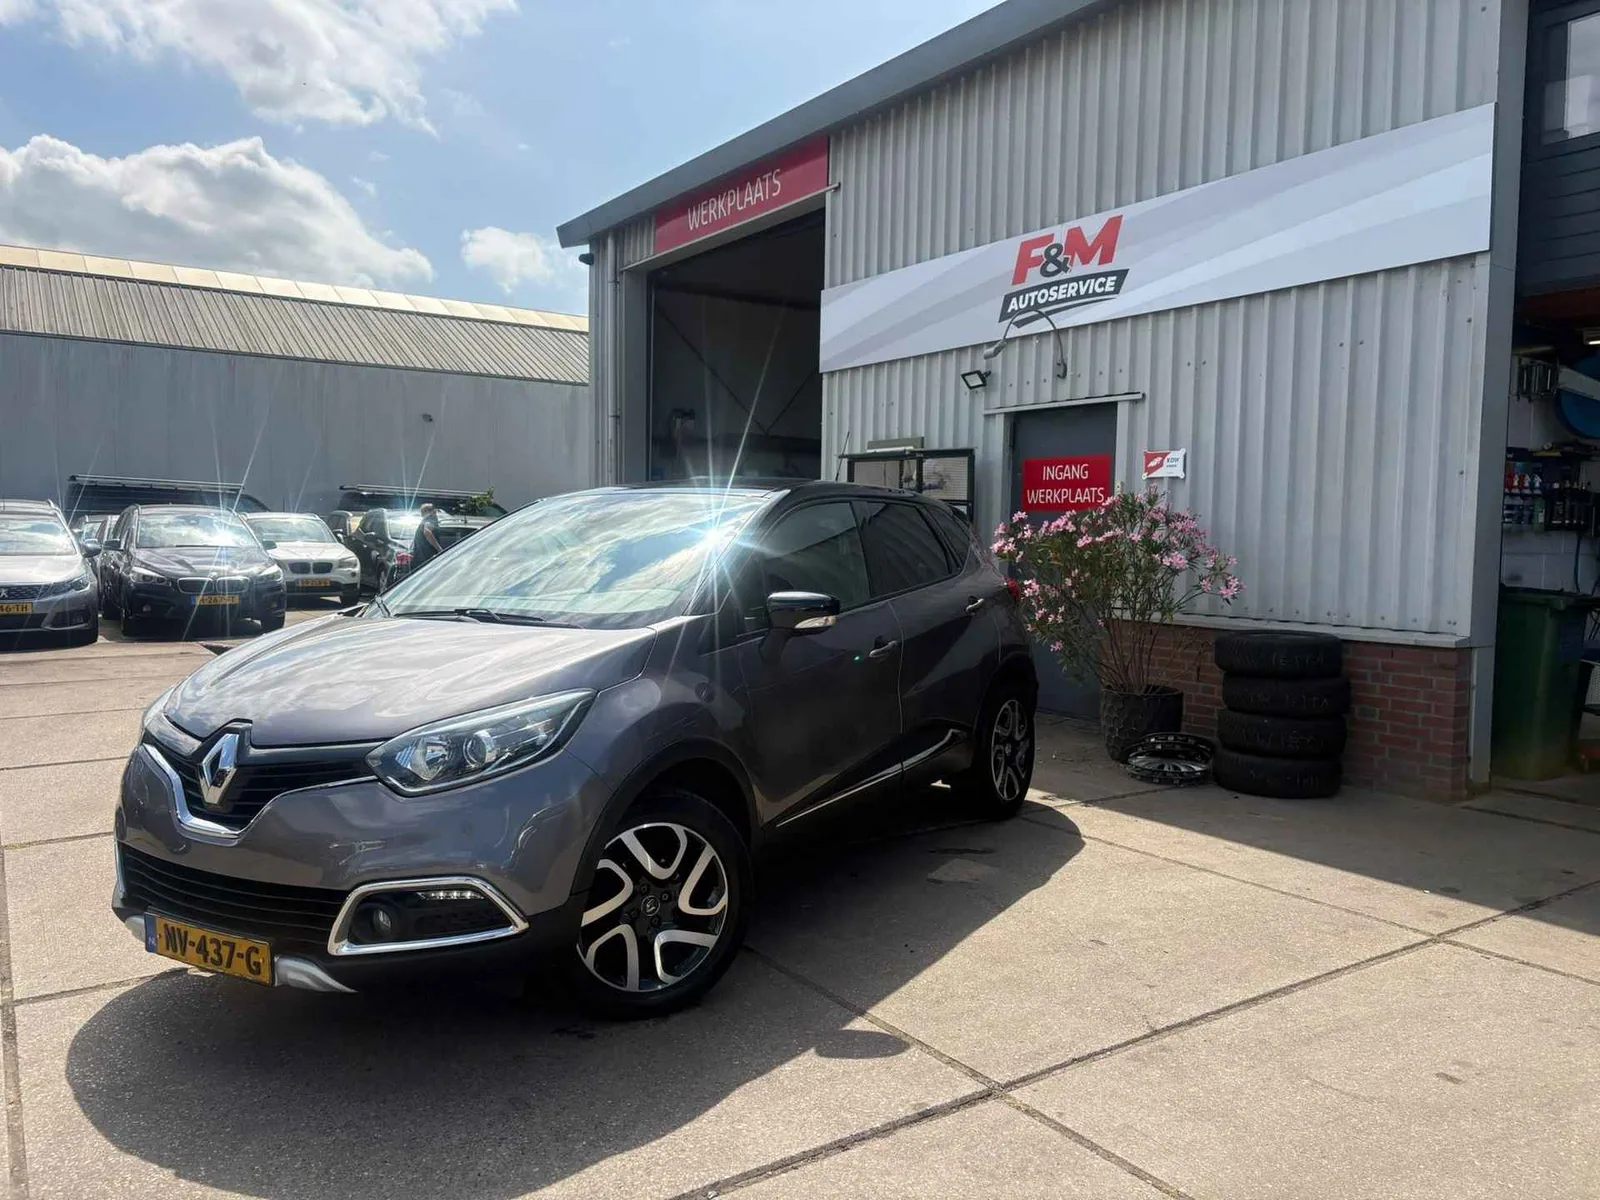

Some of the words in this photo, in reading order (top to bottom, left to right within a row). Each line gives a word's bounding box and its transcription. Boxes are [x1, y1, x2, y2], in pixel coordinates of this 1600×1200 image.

[687, 168, 782, 231] WERKPLAATS
[1012, 214, 1123, 286] F&M
[1007, 276, 1118, 313] AUTOSERVICE
[1042, 463, 1089, 481] INGANG
[1026, 487, 1105, 504] WERKPLAATS
[163, 923, 261, 975] NV-437-G
